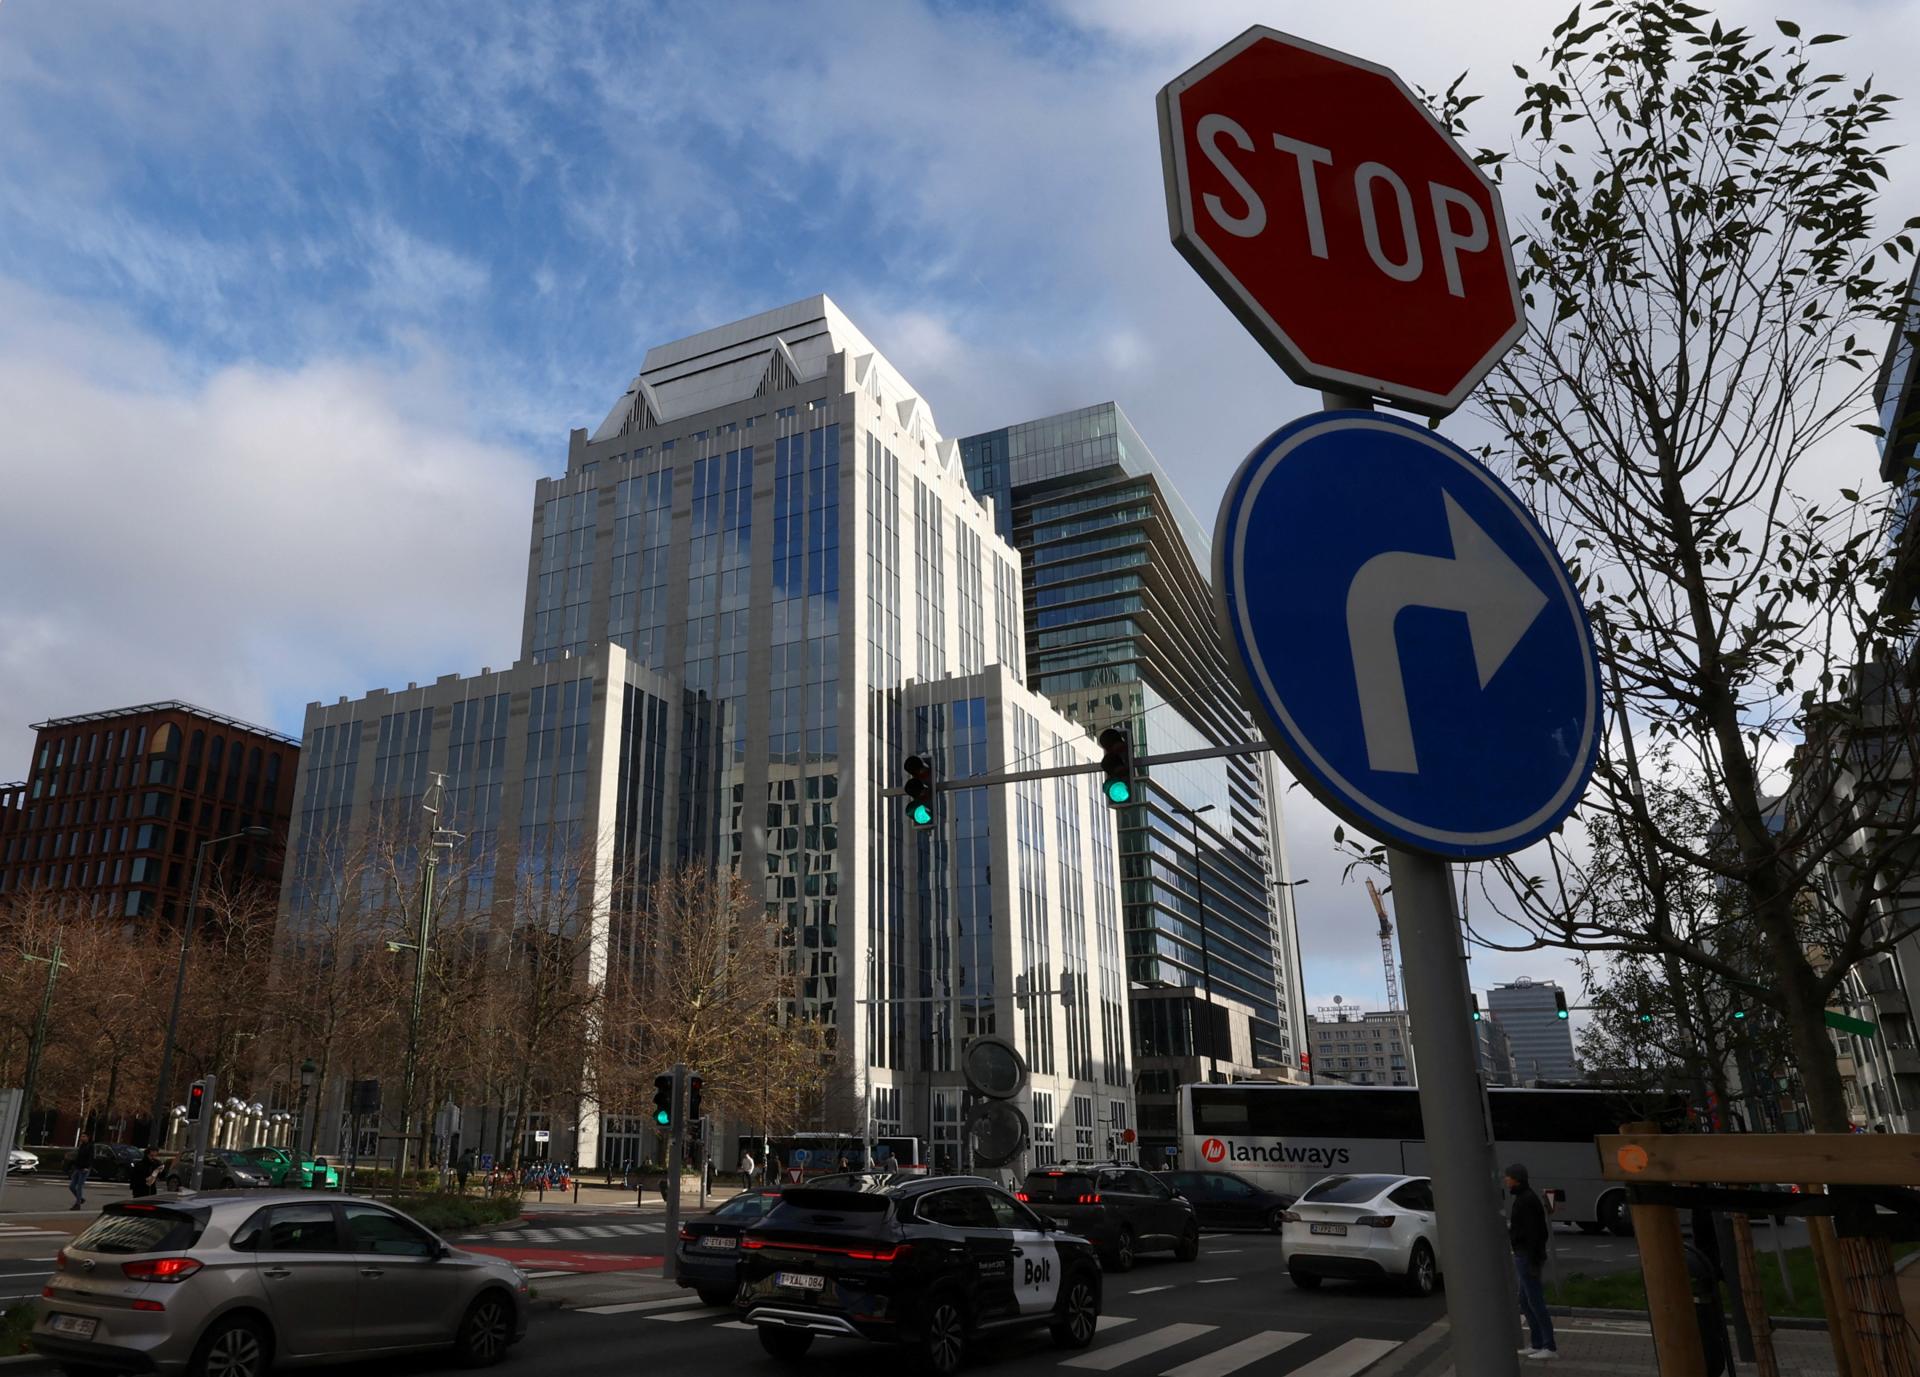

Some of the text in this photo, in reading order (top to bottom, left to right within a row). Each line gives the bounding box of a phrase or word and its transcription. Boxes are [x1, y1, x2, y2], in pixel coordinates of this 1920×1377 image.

[1196, 113, 1490, 298] STOP
[1228, 1141, 1349, 1168] landways
[1024, 1257, 1050, 1291] Bolt
